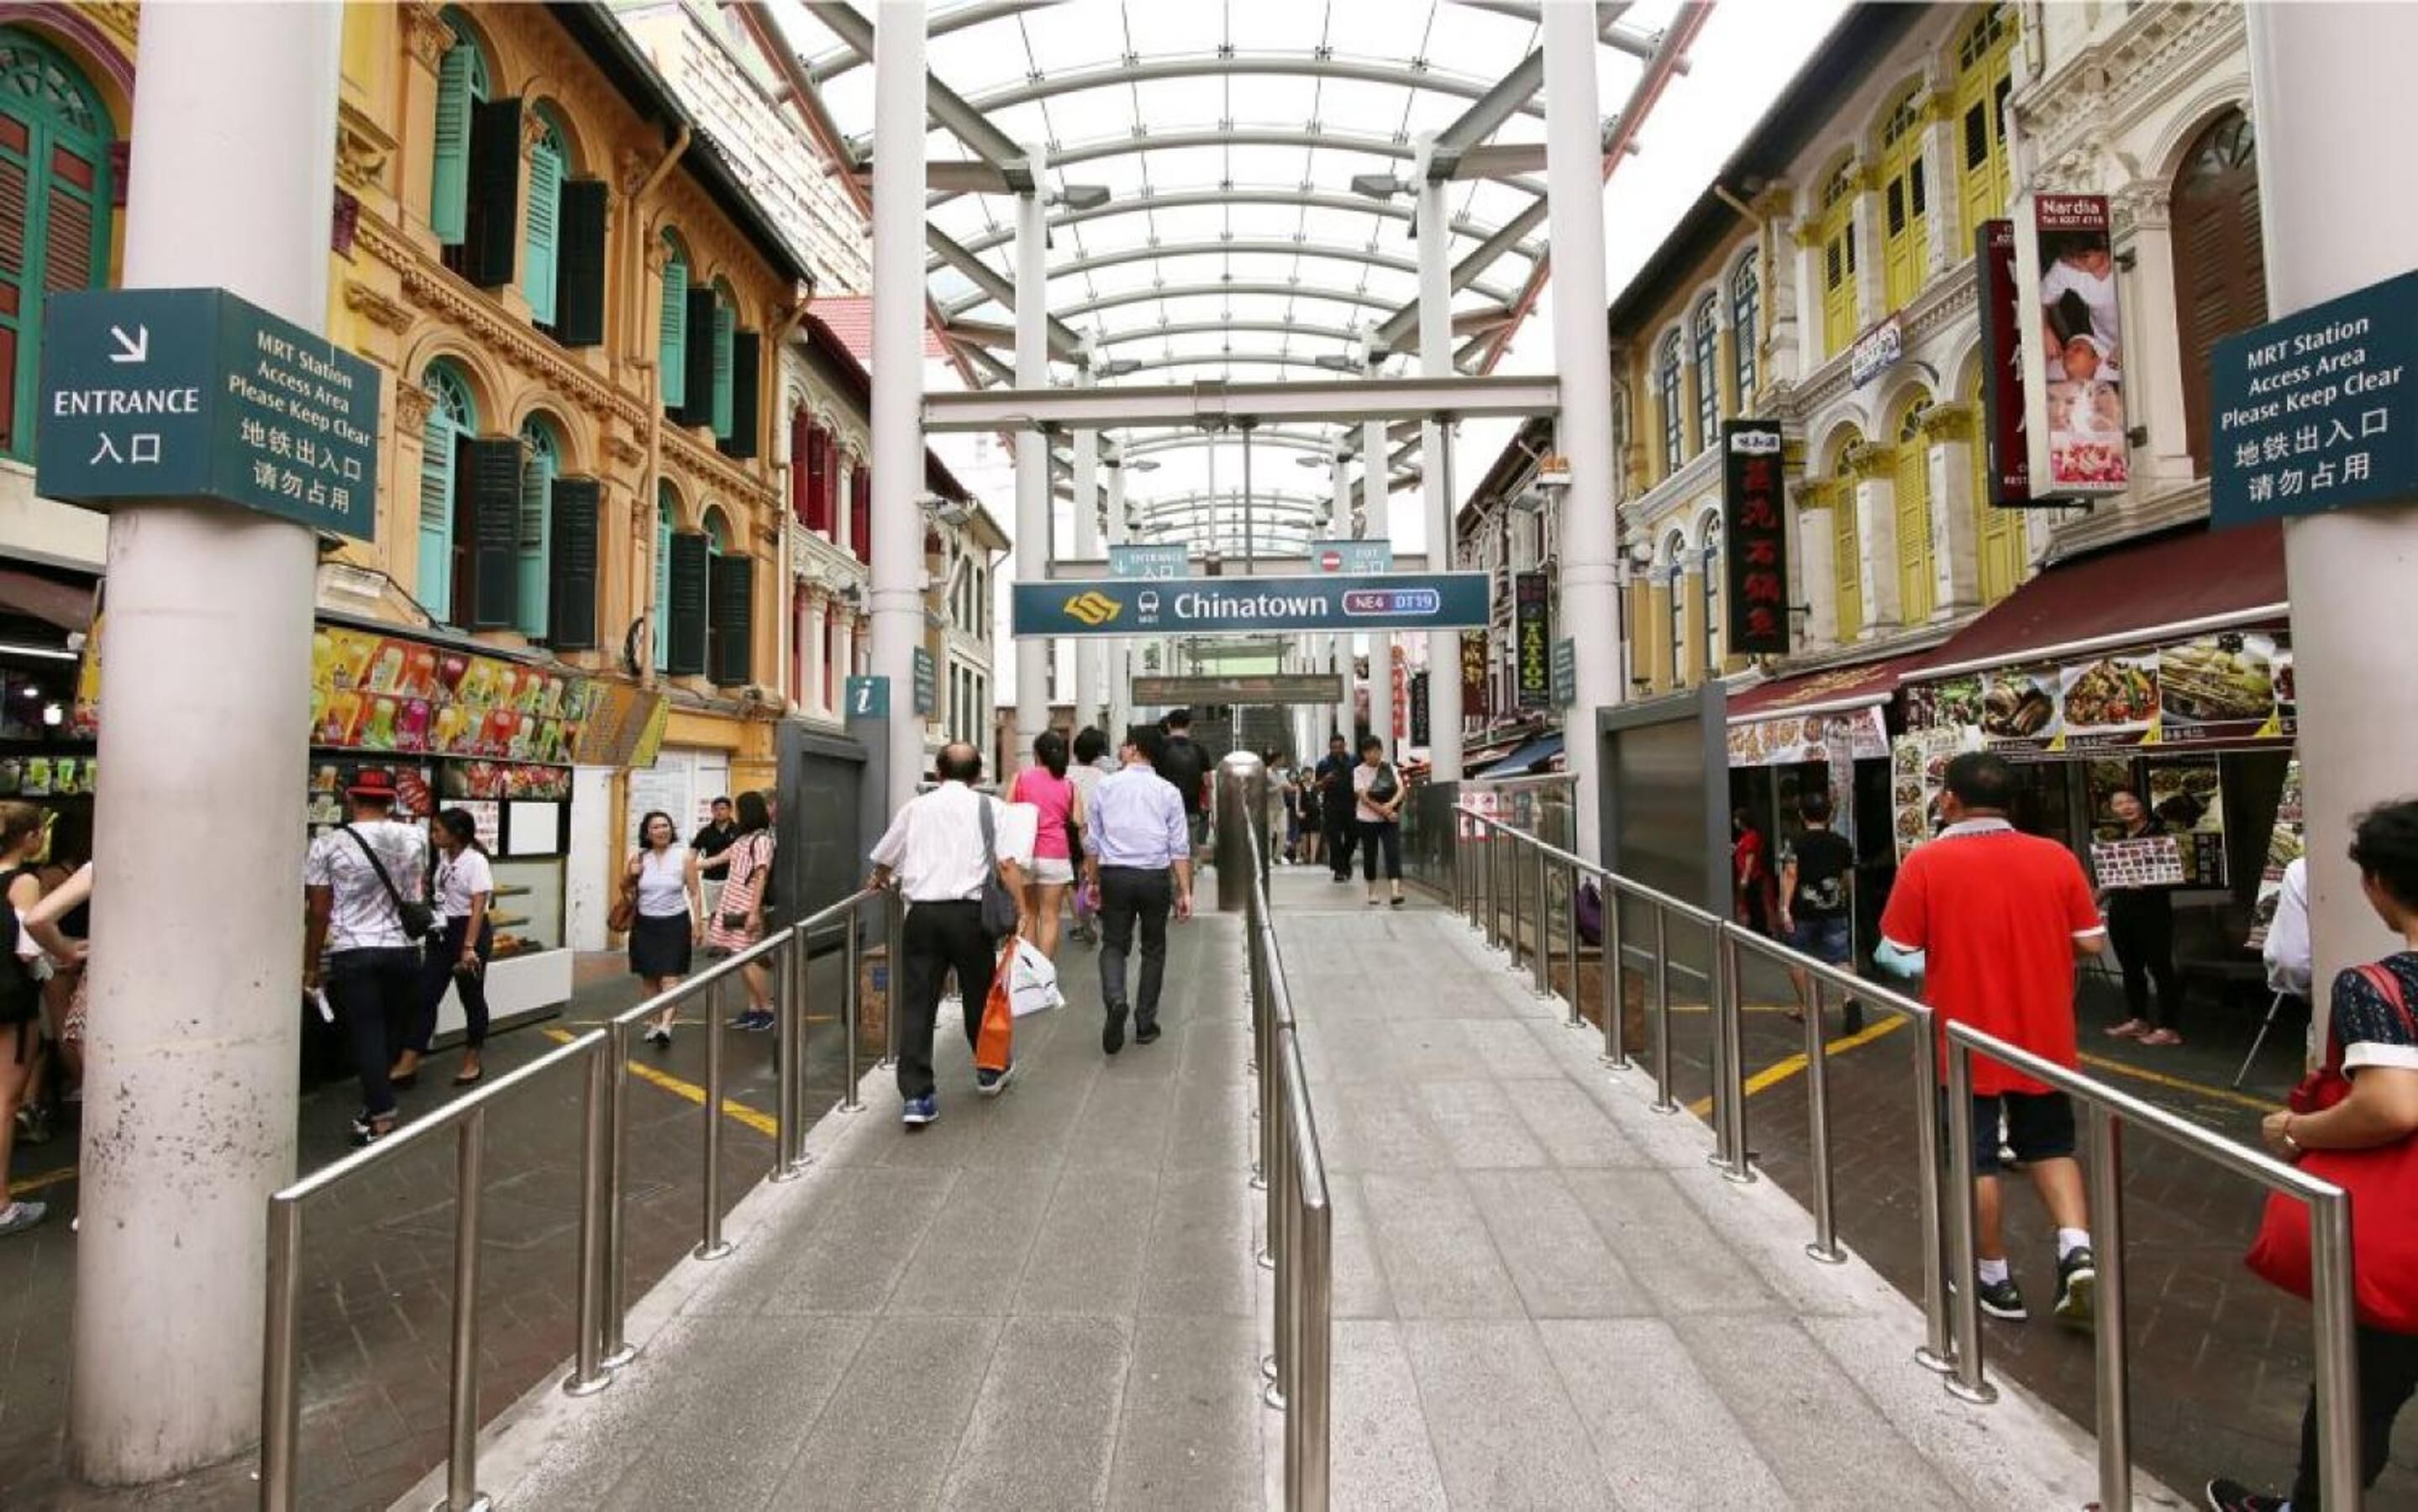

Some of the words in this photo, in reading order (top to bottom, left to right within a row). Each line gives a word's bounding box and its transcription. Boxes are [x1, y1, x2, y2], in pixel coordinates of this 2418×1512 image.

[2042, 199, 2100, 215] Nardia
[257, 330, 295, 362] MRT
[299, 350, 353, 390] Station
[2247, 339, 2289, 370] MRT
[2294, 318, 2369, 356] Station
[257, 360, 310, 397] Access
[315, 385, 350, 414] Area
[2221, 401, 2279, 431] Please
[2286, 385, 2337, 412] Keep
[2344, 365, 2405, 396] Clear
[2248, 365, 2310, 396] Access
[2315, 348, 2366, 376] Area
[54, 387, 200, 417] ENTRANCE
[229, 375, 286, 412] Please
[290, 400, 330, 433] Keep
[333, 419, 371, 447] Clear
[90, 431, 161, 465] 入口
[240, 417, 362, 482] 地铁出入口
[2234, 407, 2388, 469] 地铁出入口
[253, 461, 350, 515] 请勿占用
[2248, 452, 2371, 502] 请勿占用
[1175, 591, 1328, 619] Chinatown
[1355, 595, 1385, 609] NE4
[1395, 592, 1432, 608] DT19
